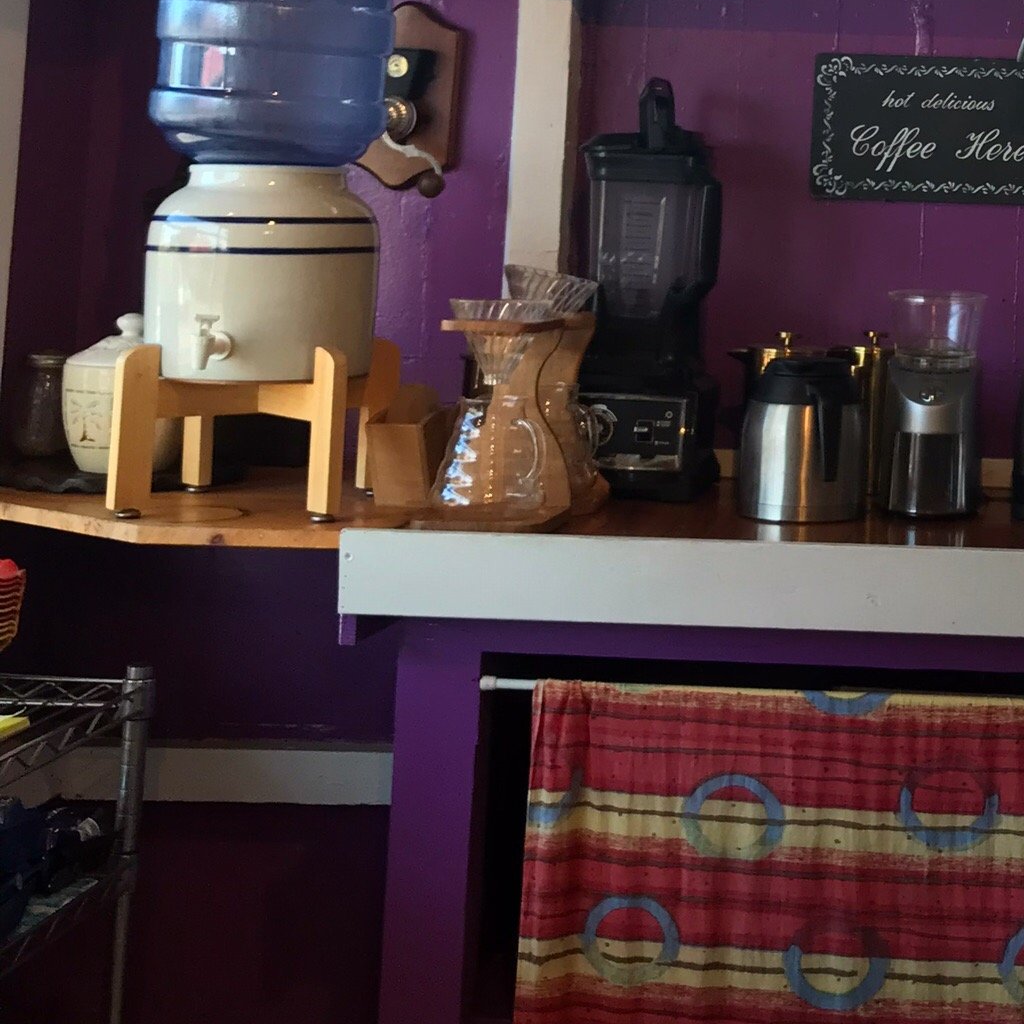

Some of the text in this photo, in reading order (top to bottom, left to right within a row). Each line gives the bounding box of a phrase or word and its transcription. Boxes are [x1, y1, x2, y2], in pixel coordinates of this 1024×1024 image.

[881, 90, 995, 111] hot delicious
[850, 124, 937, 173] Coffee
